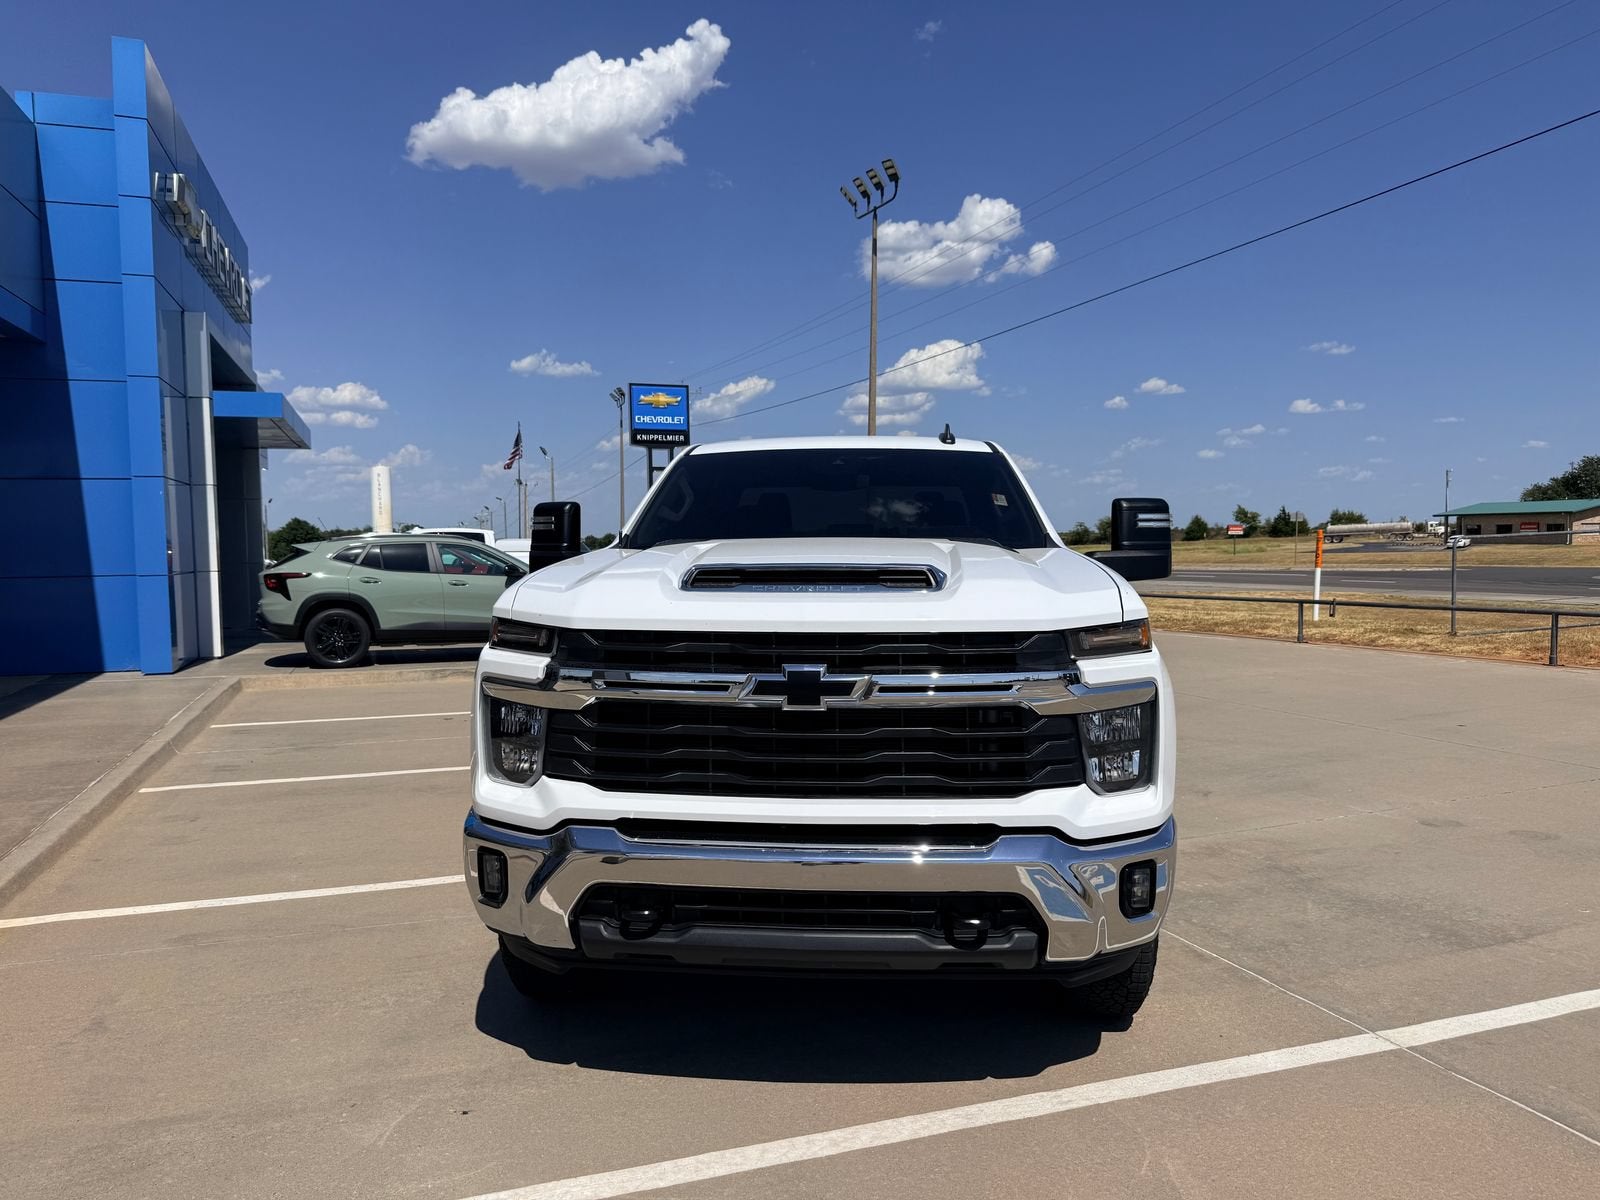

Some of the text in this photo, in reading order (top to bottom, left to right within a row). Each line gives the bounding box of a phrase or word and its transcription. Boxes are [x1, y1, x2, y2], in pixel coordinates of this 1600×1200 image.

[635, 415, 685, 424] CHEVROLET
[636, 434, 685, 442] KNIPPELMIER
[752, 584, 865, 593] CHEVROLET
